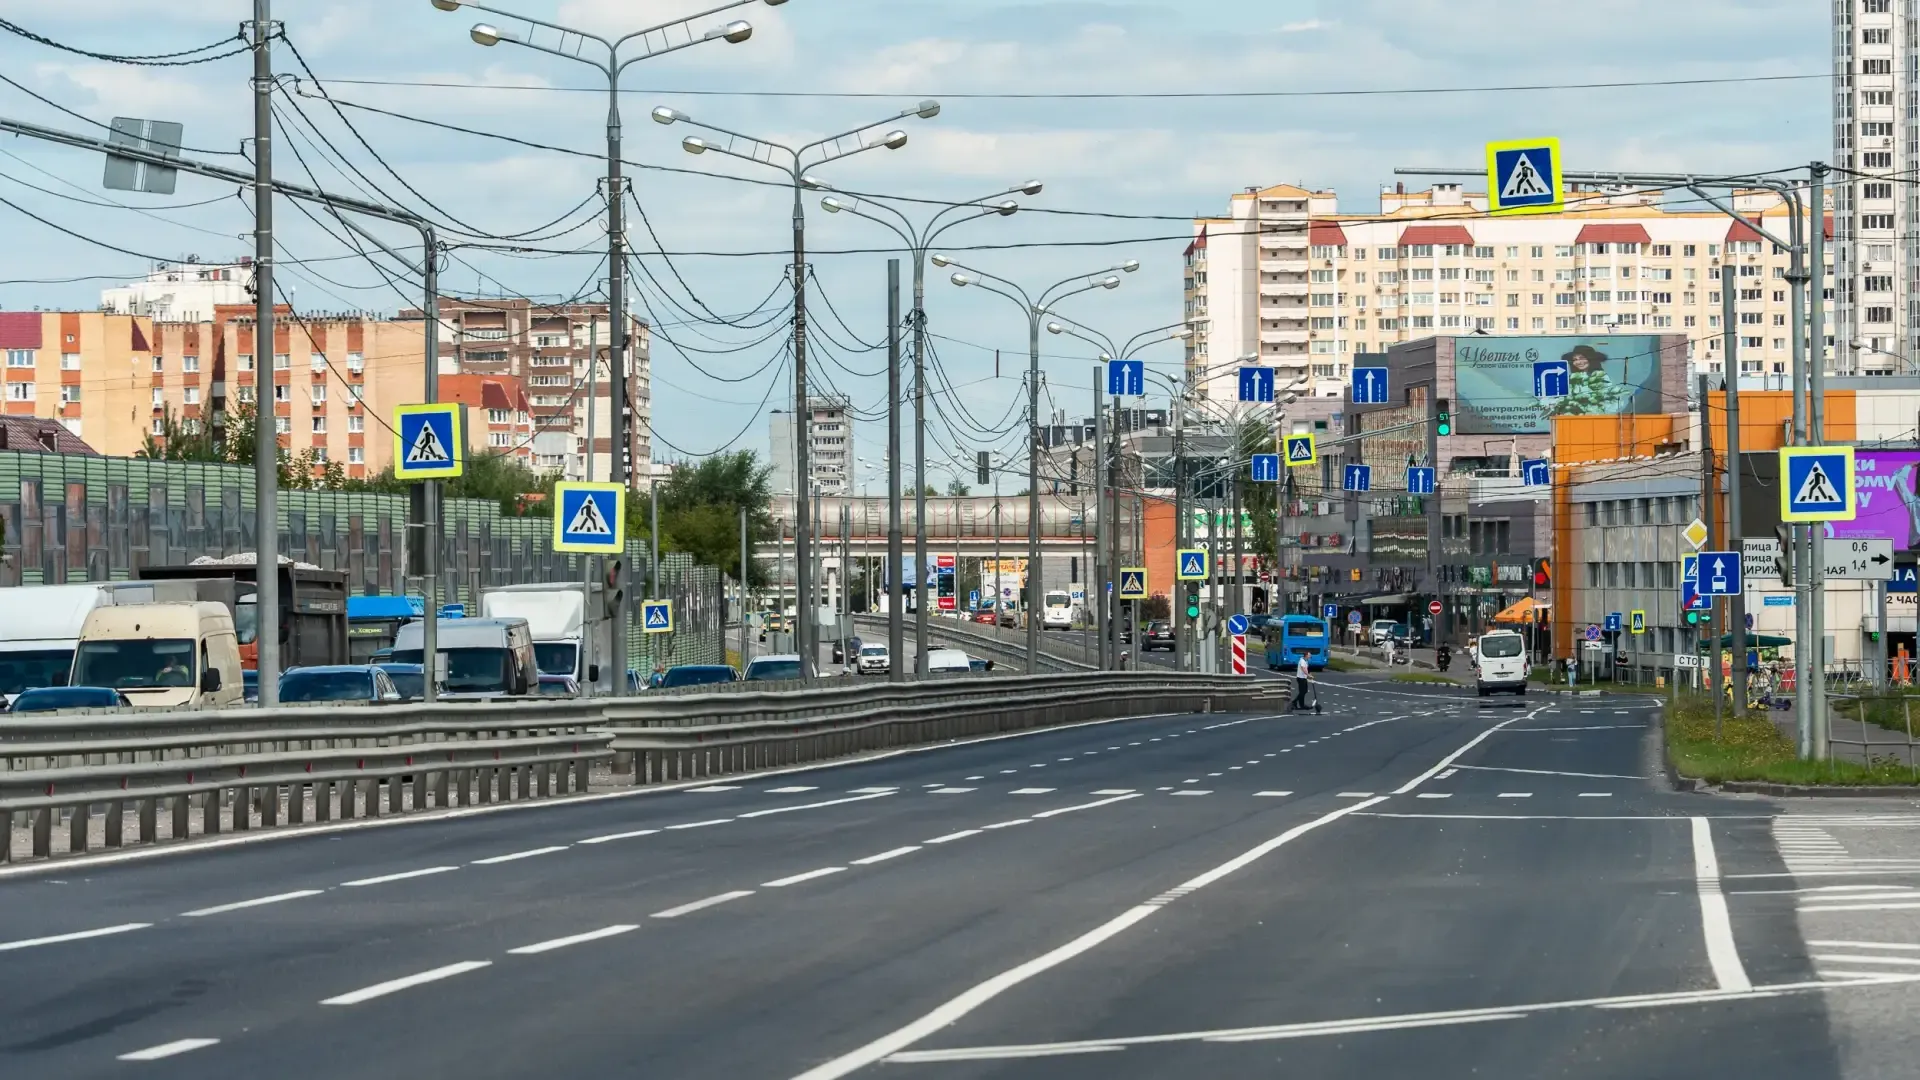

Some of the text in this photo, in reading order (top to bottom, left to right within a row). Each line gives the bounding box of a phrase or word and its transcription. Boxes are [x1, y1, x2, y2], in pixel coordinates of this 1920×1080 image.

[1460, 346, 1520, 368] Цветы
[1743, 543, 1772, 552] лица
[1852, 541, 1868, 553] 0,6
[1743, 555, 1772, 563] лица
[1852, 559, 1867, 571] 1,4
[1679, 656, 1705, 666] СТОП
